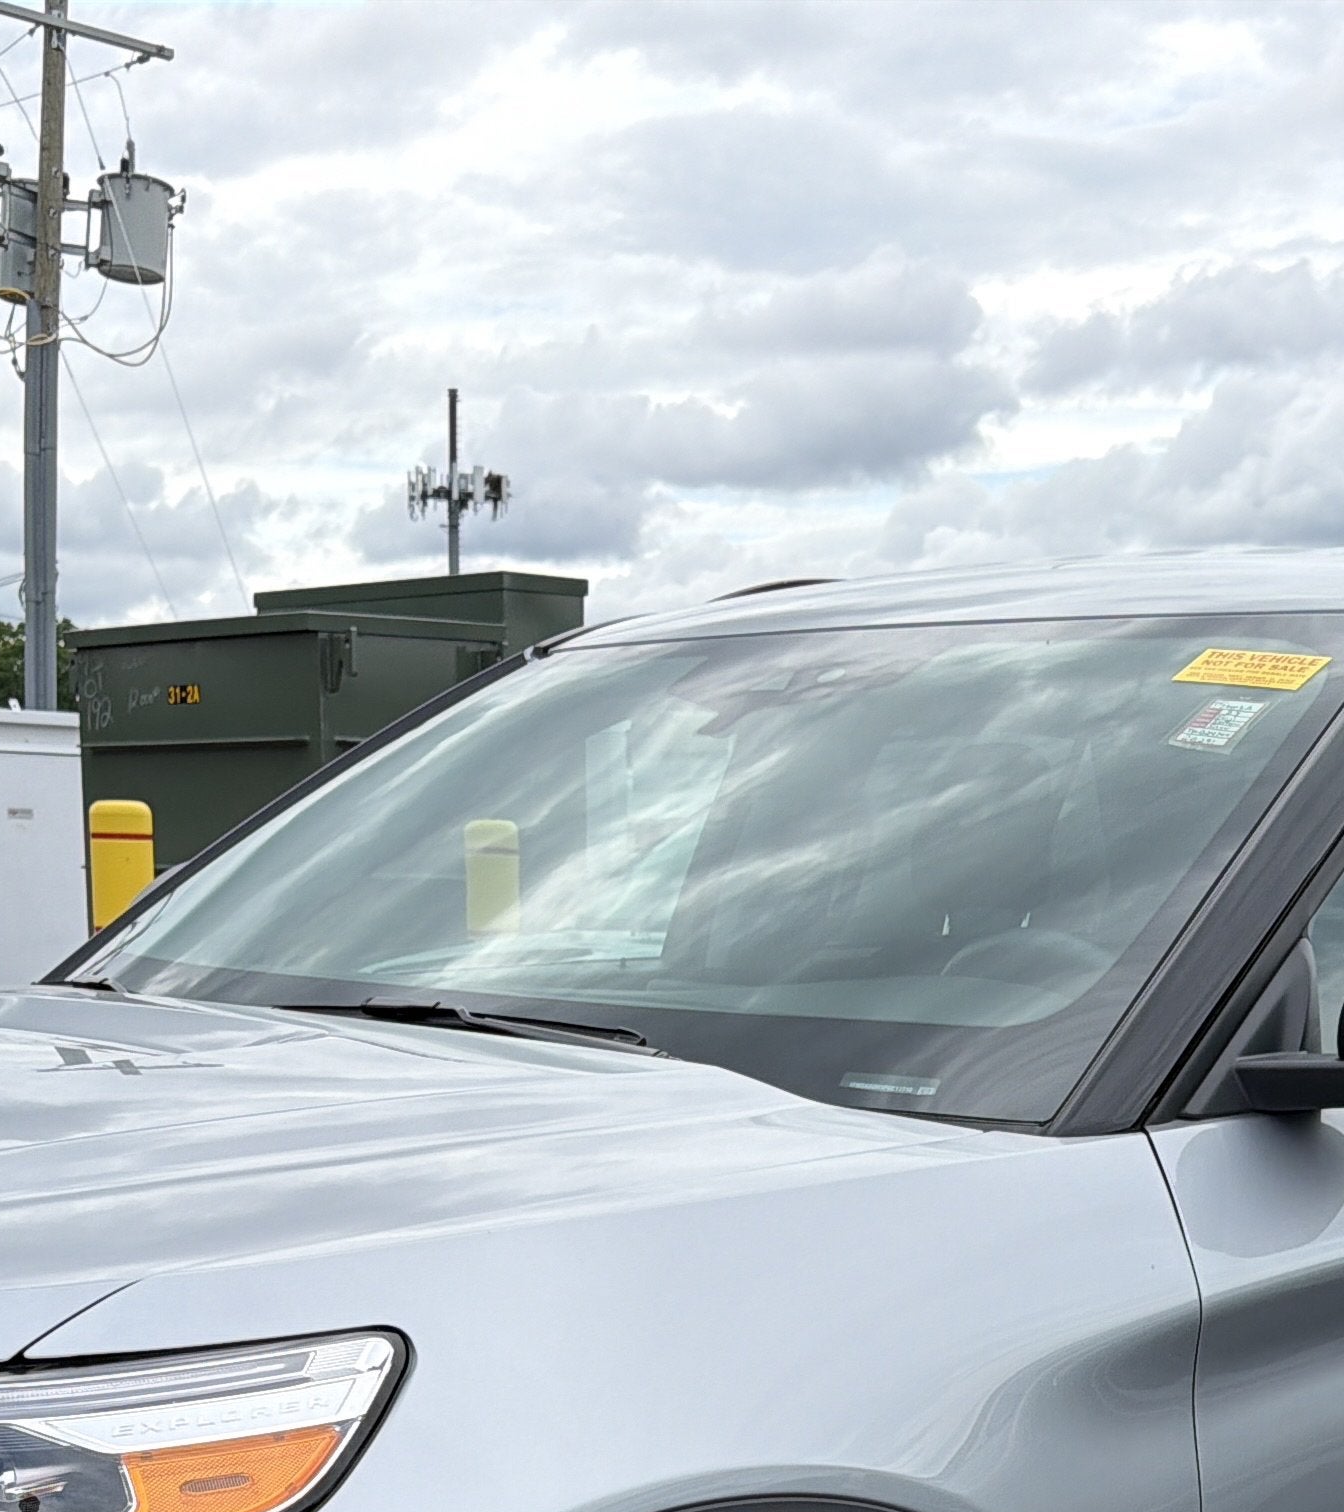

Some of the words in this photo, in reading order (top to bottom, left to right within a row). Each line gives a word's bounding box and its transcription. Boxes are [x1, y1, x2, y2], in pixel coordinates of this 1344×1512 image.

[1207, 651, 1244, 662] THIS
[1250, 652, 1323, 667] VEHICLE
[1234, 661, 1267, 670] FOR
[1268, 664, 1311, 673] SALE
[111, 1397, 330, 1438] EXPLORER
